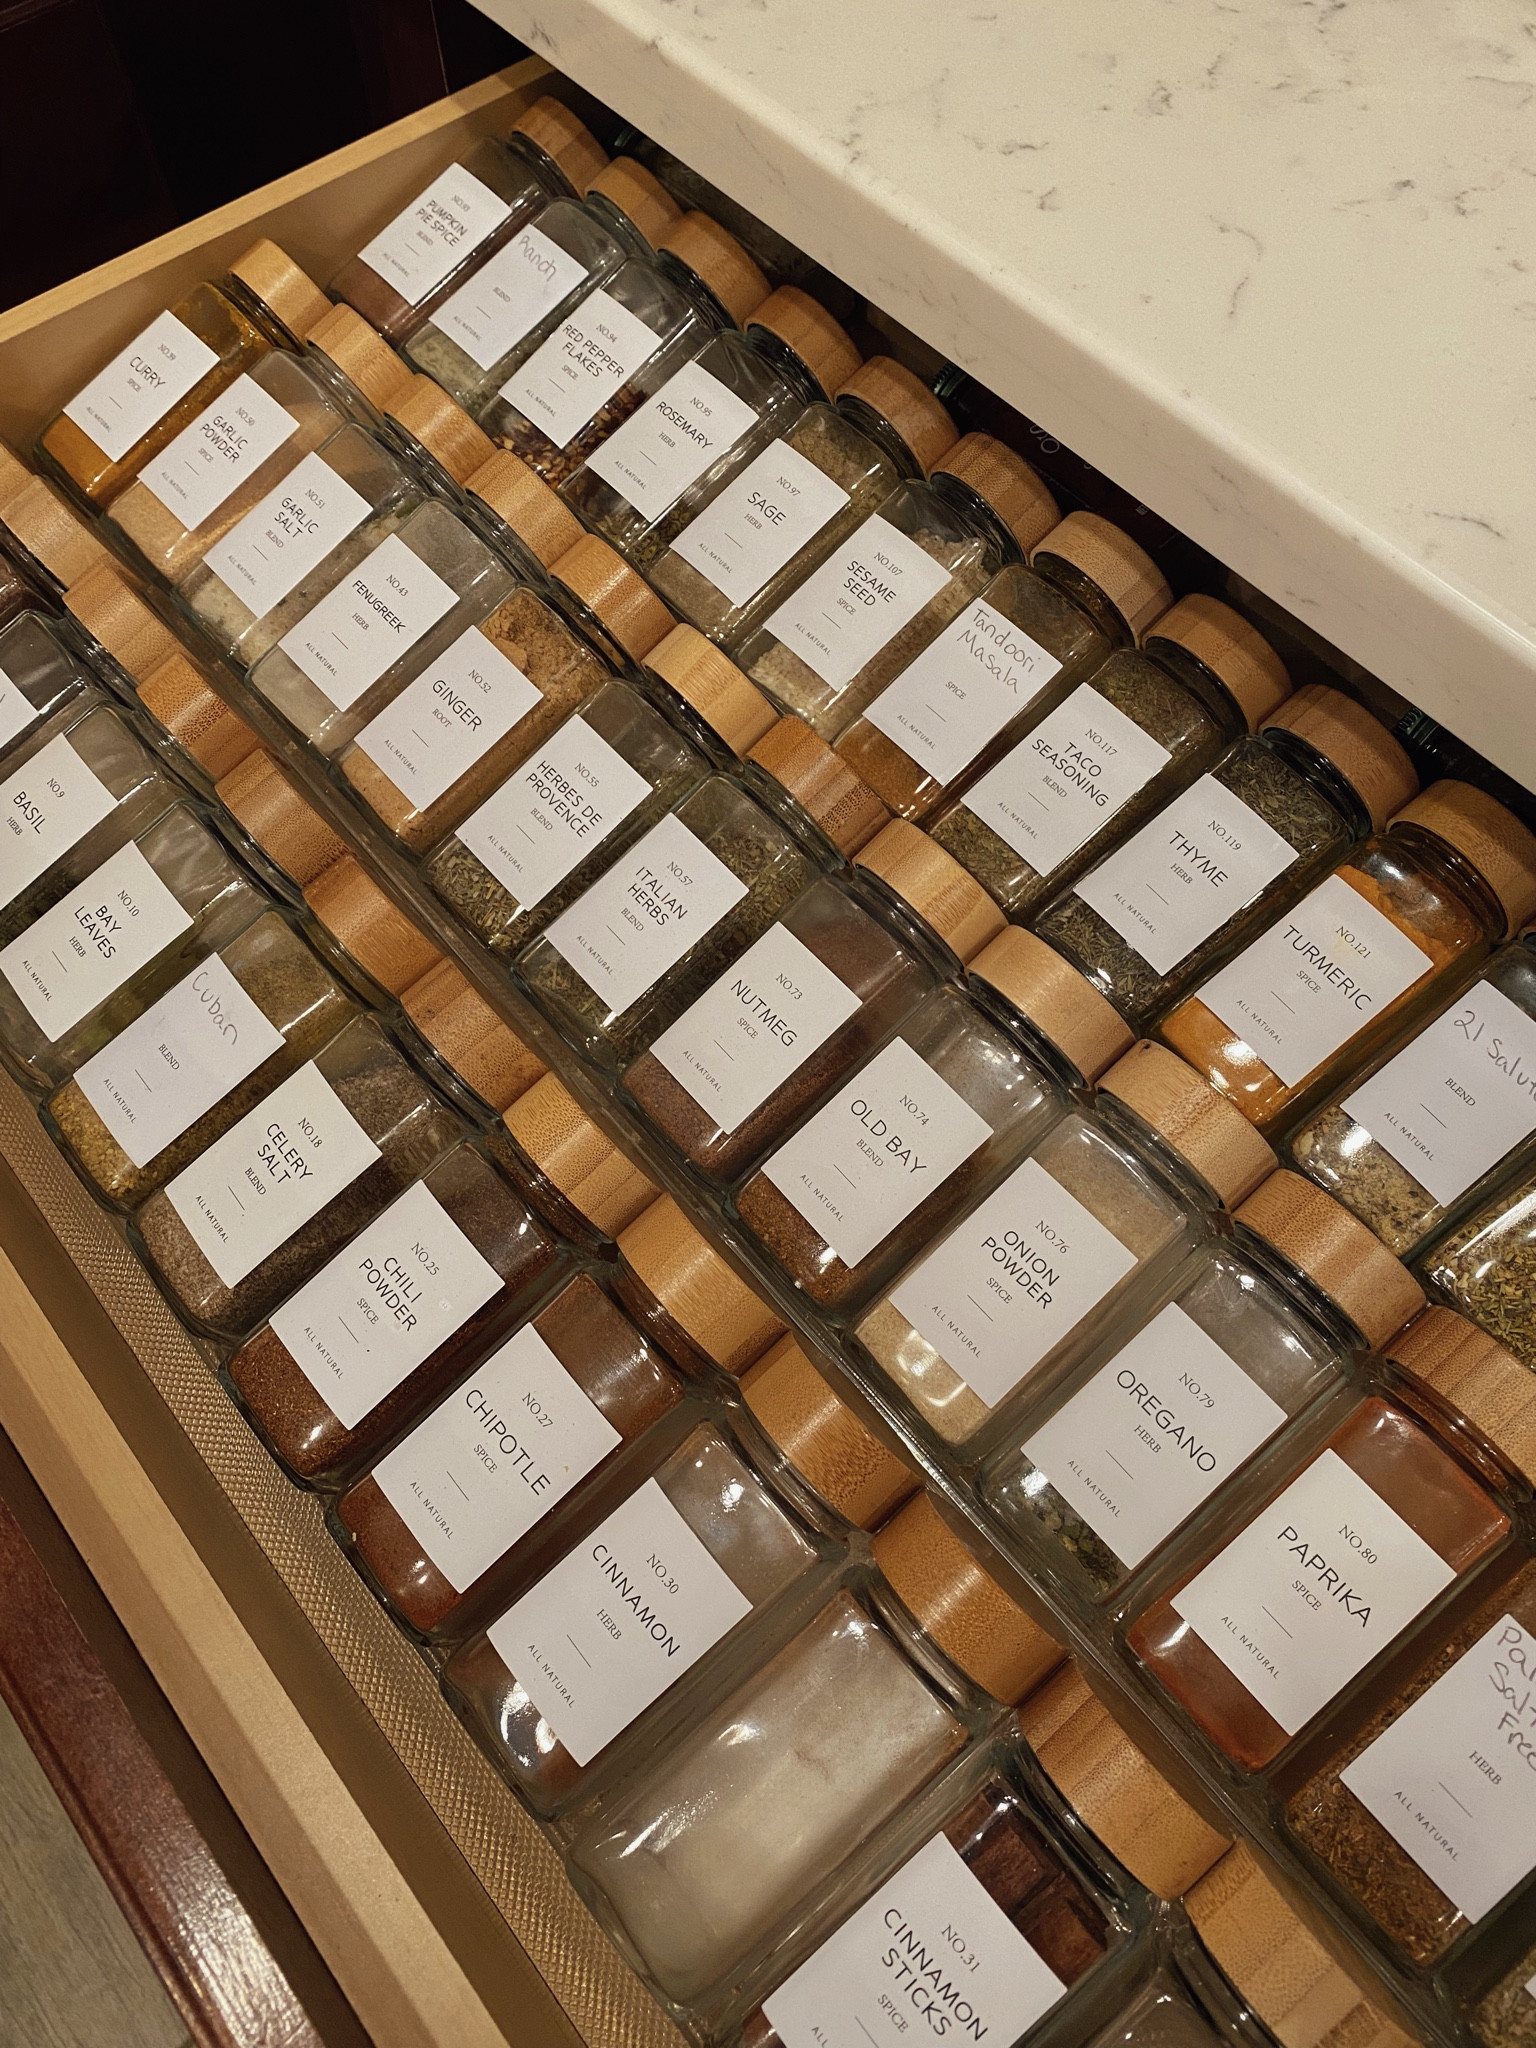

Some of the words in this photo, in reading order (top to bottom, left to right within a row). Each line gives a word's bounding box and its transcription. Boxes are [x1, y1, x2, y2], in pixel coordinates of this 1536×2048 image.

[416, 208, 434, 224] PIE
[430, 220, 460, 247] SPICE
[426, 200, 468, 237] PUMPKIN
[562, 324, 584, 343] RED
[582, 339, 625, 378] PEPPER
[562, 342, 603, 377] FLAKES
[130, 356, 166, 389] CURRY
[656, 401, 713, 449] ROSEMARY
[690, 397, 713, 417] NO.95
[202, 423, 240, 460] POWDER
[213, 415, 248, 450] GARLIC
[658, 432, 676, 448] HERB
[305, 489, 326, 510] NO.51
[776, 476, 801, 496] NO.97
[274, 511, 303, 538] SALT
[281, 497, 319, 534] GARLIC
[744, 513, 763, 530] HERB
[747, 491, 786, 526] SAGE
[265, 529, 285, 548] BLEND
[847, 560, 897, 603] SESAME
[873, 552, 903, 576] NO.107
[386, 574, 409, 597] NO.43
[843, 577, 876, 606] SEED
[352, 580, 406, 634] FENUGREEK
[352, 612, 370, 631] HERB
[836, 597, 857, 616] SPICE
[971, 608, 1041, 673] Tandoori
[306, 642, 315, 653] ALL
[315, 651, 337, 676] NATURAL
[956, 629, 1018, 694] Masala
[468, 669, 492, 694] NO.52
[945, 681, 967, 700] SPICE
[432, 680, 482, 732] GINGER
[432, 708, 453, 728] ROOT
[897, 714, 908, 726] ALL
[909, 724, 936, 750] NATURAL
[1085, 728, 1118, 756] NO.117
[384, 739, 395, 751] ALL
[394, 749, 417, 775] NATURAL
[574, 762, 600, 787] NO.55
[1031, 739, 1109, 807] SEASONING
[1064, 742, 1102, 777] TACO
[46, 778, 65, 798] NO.9
[536, 760, 584, 807] HERBES
[581, 805, 603, 827] DE
[1042, 775, 1068, 798] BLEND
[13, 791, 46, 834] BASIL
[525, 772, 590, 838] PROVENCE
[530, 807, 553, 831] BLEND
[998, 802, 1010, 814] ALL
[1010, 812, 1038, 840] NATURAL
[6, 816, 23, 836] HERB
[1208, 820, 1242, 850] NO.119
[488, 835, 499, 847] ALL
[498, 845, 523, 873] NATURAL
[1169, 830, 1229, 888] THYME
[666, 861, 694, 886] NO.57
[1170, 863, 1193, 884] HERB
[117, 890, 140, 917] NO.10
[627, 883, 670, 926] HERBS
[635, 866, 688, 920] ITALIAN
[95, 905, 122, 933] BAY
[620, 907, 644, 932] BLEND
[1114, 893, 1126, 906] ALL
[1127, 904, 1156, 934] NATURAL
[69, 936, 87, 958] HERB
[74, 906, 116, 959] LEAVES
[1336, 926, 1371, 959] NO.121
[577, 935, 588, 948] ALL
[587, 946, 613, 976] NATURAL
[1283, 924, 1372, 1010] TURMERIC
[23, 960, 33, 973] ALL
[30, 972, 52, 1001] NATURAL
[775, 973, 803, 1000] NO.73
[1298, 970, 1321, 994] SPICE
[192, 971, 239, 1046] Cuban
[730, 979, 798, 1047] NUTMEG
[1236, 1000, 1250, 1014] ALL
[1251, 1013, 1282, 1044] NATURAL
[736, 1017, 759, 1039] SPICE
[158, 1043, 180, 1070] BLEND
[683, 1050, 695, 1063] ALL
[695, 1062, 721, 1092] NATURAL
[1454, 1010, 1485, 1042] 21
[1486, 1038, 1536, 1102] Salut
[104, 1078, 114, 1092] ALL
[113, 1091, 136, 1124] NATURAL
[1445, 1078, 1476, 1106] BLEND
[899, 1095, 930, 1126] NO.74
[298, 1117, 323, 1148] NO.18
[850, 1099, 887, 1137] OLD
[885, 1135, 927, 1174] BAY
[1384, 1112, 1399, 1127] ALL
[1400, 1126, 1434, 1161] NATURAL
[257, 1144, 291, 1184] SALT
[267, 1123, 314, 1180] CELERY
[856, 1138, 884, 1167] BLEND
[244, 1167, 267, 1195] BLEND
[800, 1174, 813, 1189] ALL
[814, 1188, 843, 1222] NATURAL
[196, 1195, 206, 1210] ALL
[205, 1209, 228, 1243] NATURAL
[1035, 1220, 1069, 1254] NO.76
[411, 1242, 440, 1276] NO.25
[981, 1236, 1053, 1310] POWDER
[1003, 1230, 1060, 1287] ONION
[358, 1258, 417, 1332] POWDER
[384, 1257, 423, 1304] CHILI
[986, 1277, 1011, 1302] SPICE
[356, 1298, 379, 1325] SPICE
[932, 1306, 946, 1321] ALL
[947, 1321, 981, 1358] NATURAL
[304, 1327, 316, 1343] ALL
[316, 1342, 343, 1379] NATURAL
[1179, 1372, 1215, 1408] NO.79
[522, 1392, 554, 1428] NO.27
[1117, 1370, 1216, 1472] OREGANO
[466, 1389, 551, 1496] CHIPOTLE
[1134, 1425, 1162, 1453] HERB
[475, 1444, 496, 1474] SPICE
[1068, 1460, 1083, 1478] ALL
[1084, 1477, 1120, 1518] NATURAL
[410, 1482, 423, 1498] ALL
[423, 1498, 453, 1539] NATURAL
[1338, 1524, 1378, 1564] NO.80
[646, 1554, 679, 1594] NO.30
[1277, 1526, 1371, 1628] PAPRIKA
[592, 1544, 681, 1657] CINNAMON
[1292, 1580, 1322, 1608] SPICE
[596, 1608, 622, 1640] HERB
[1221, 1616, 1238, 1635] ALL
[1239, 1635, 1279, 1679] NATURAL
[528, 1644, 542, 1663] ALL
[542, 1663, 574, 1708] NATURAL
[1469, 1751, 1502, 1785] HERB
[1394, 1791, 1412, 1811] ALL
[1415, 1812, 1458, 1861] NATURAL
[941, 1924, 980, 1972] NO.31
[881, 1948, 952, 2036] STICKS
[884, 1908, 988, 2041] CINNAMON
[877, 1993, 909, 2033] SPICE
[811, 2026, 828, 2047] ALL
